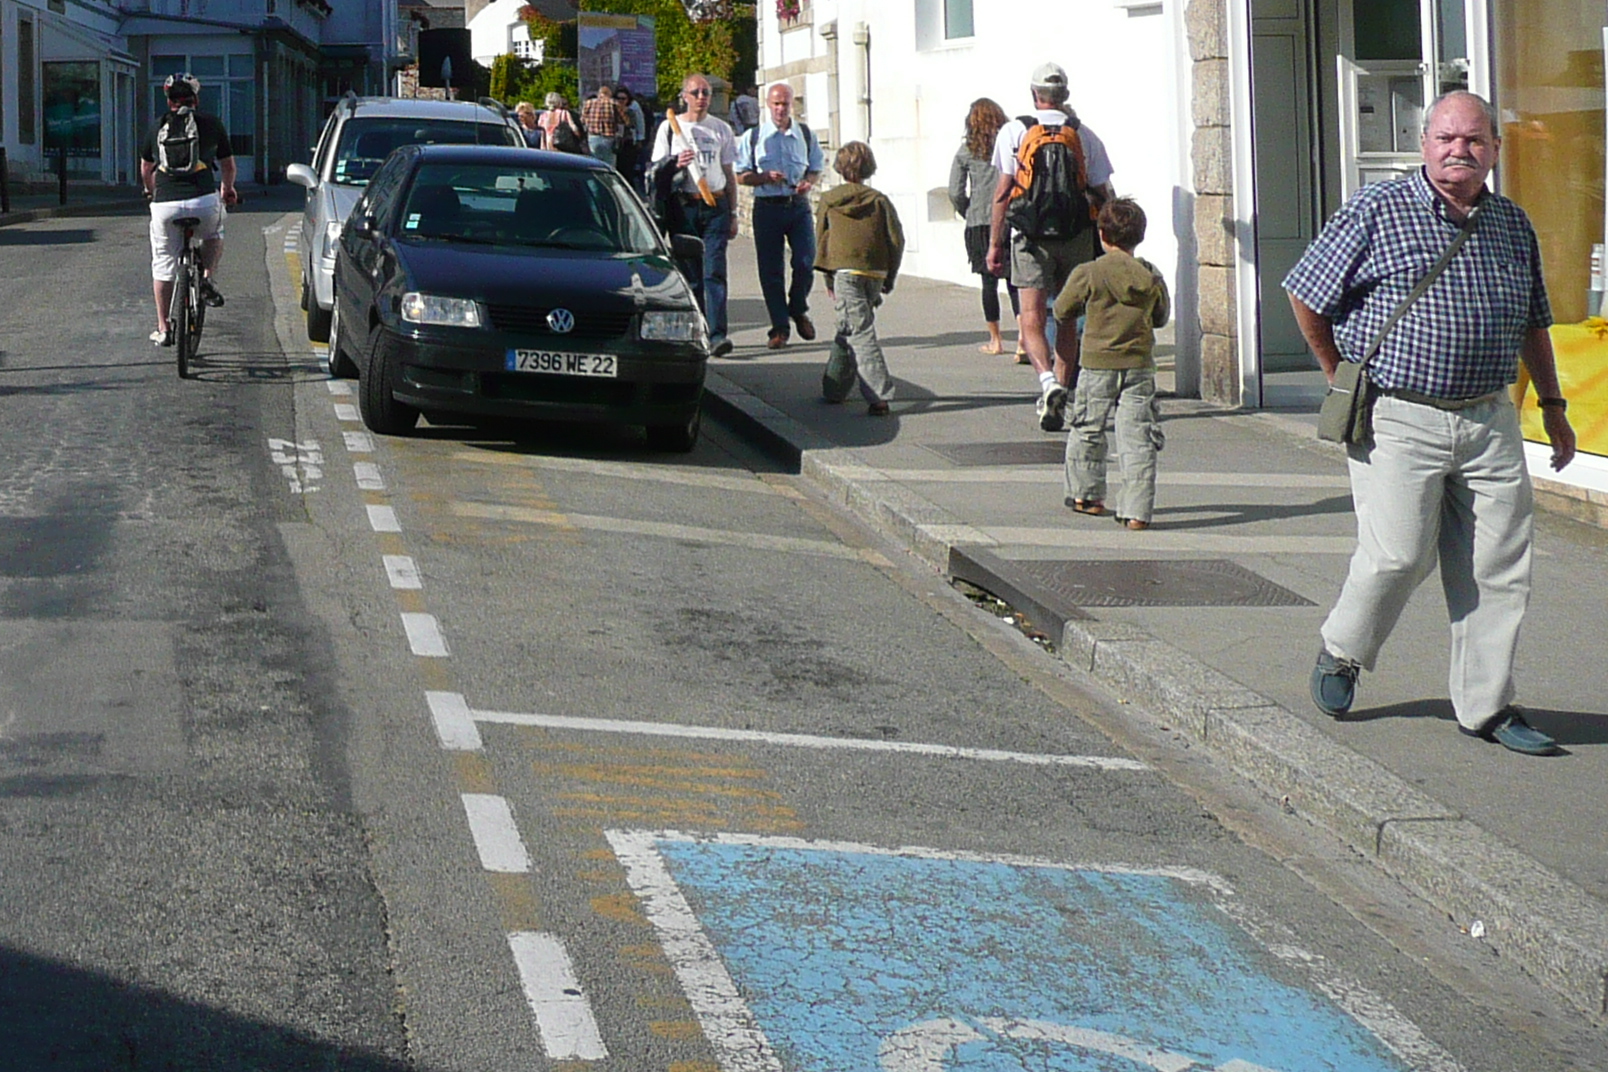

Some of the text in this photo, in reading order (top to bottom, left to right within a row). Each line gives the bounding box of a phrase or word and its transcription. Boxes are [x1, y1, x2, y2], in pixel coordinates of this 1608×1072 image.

[517, 351, 614, 375] 7396 WE 22
